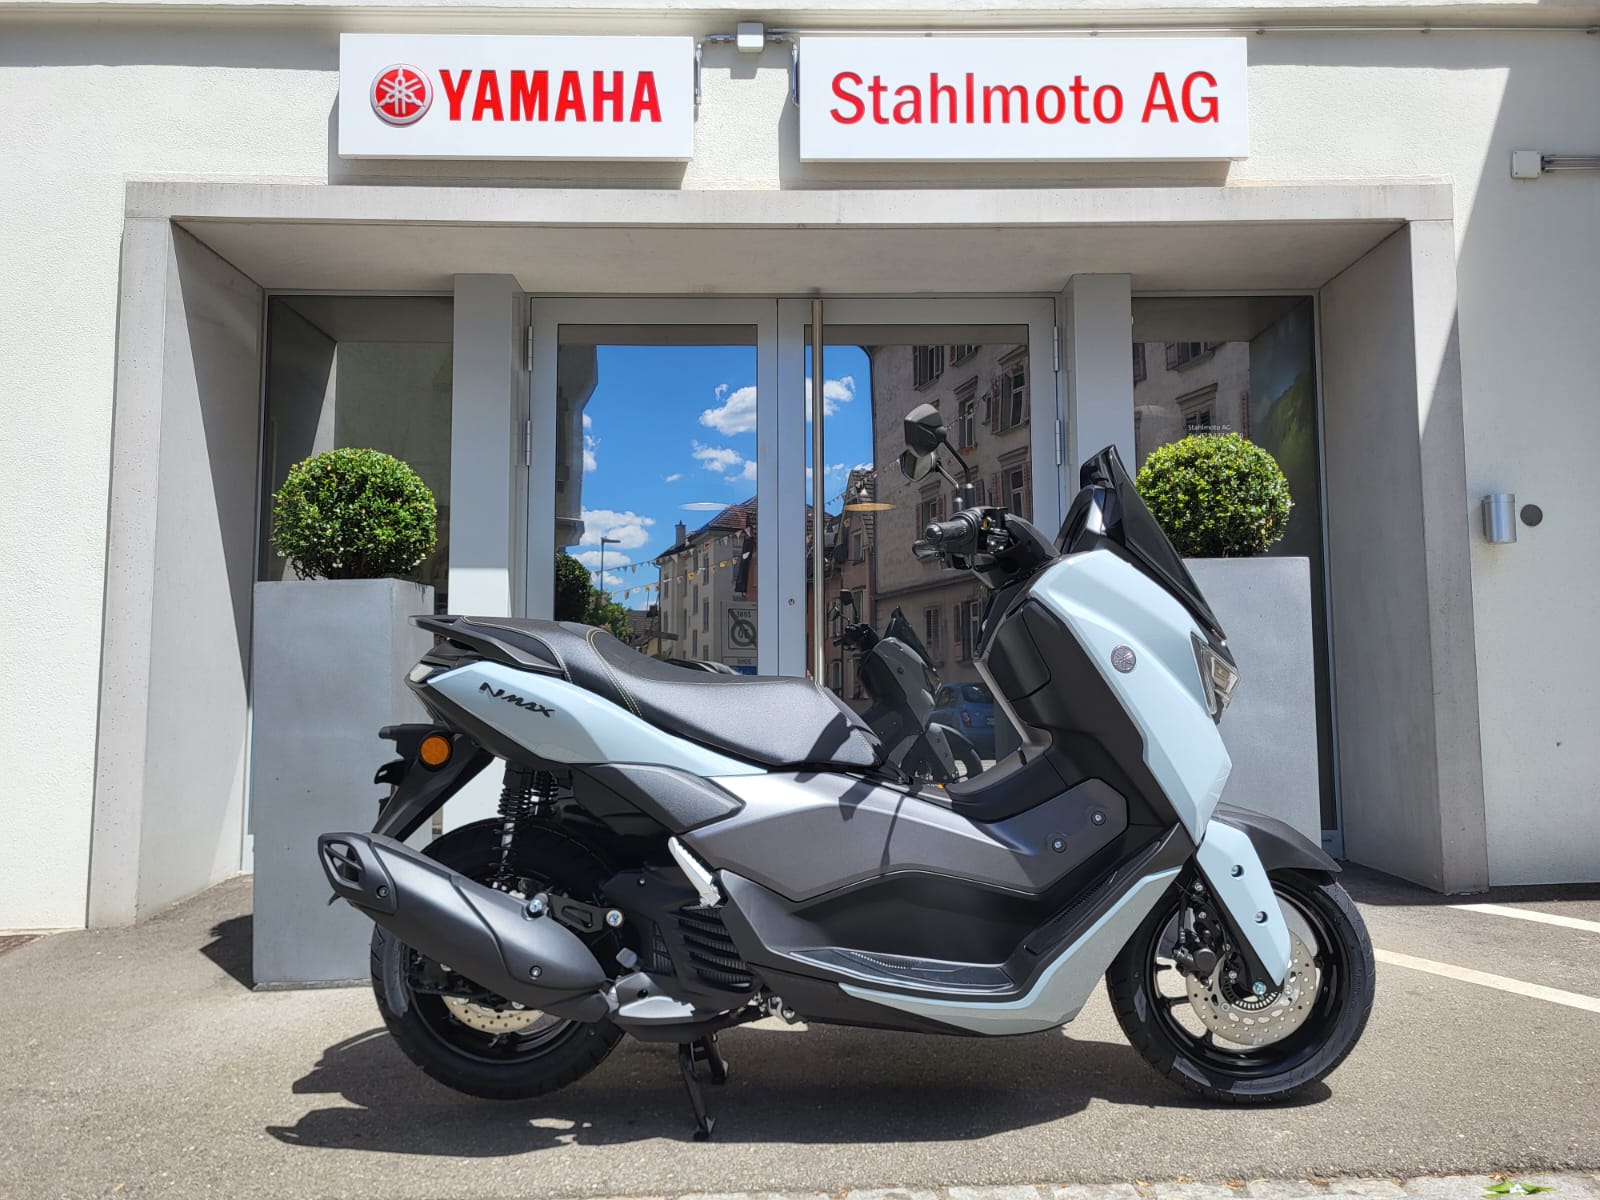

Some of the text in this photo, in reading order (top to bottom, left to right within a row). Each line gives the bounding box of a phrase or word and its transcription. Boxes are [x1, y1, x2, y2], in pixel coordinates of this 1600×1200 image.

[440, 70, 662, 123] YAMAHA
[831, 71, 1219, 124] Stahlmoto AG
[479, 682, 556, 718] NMAX
